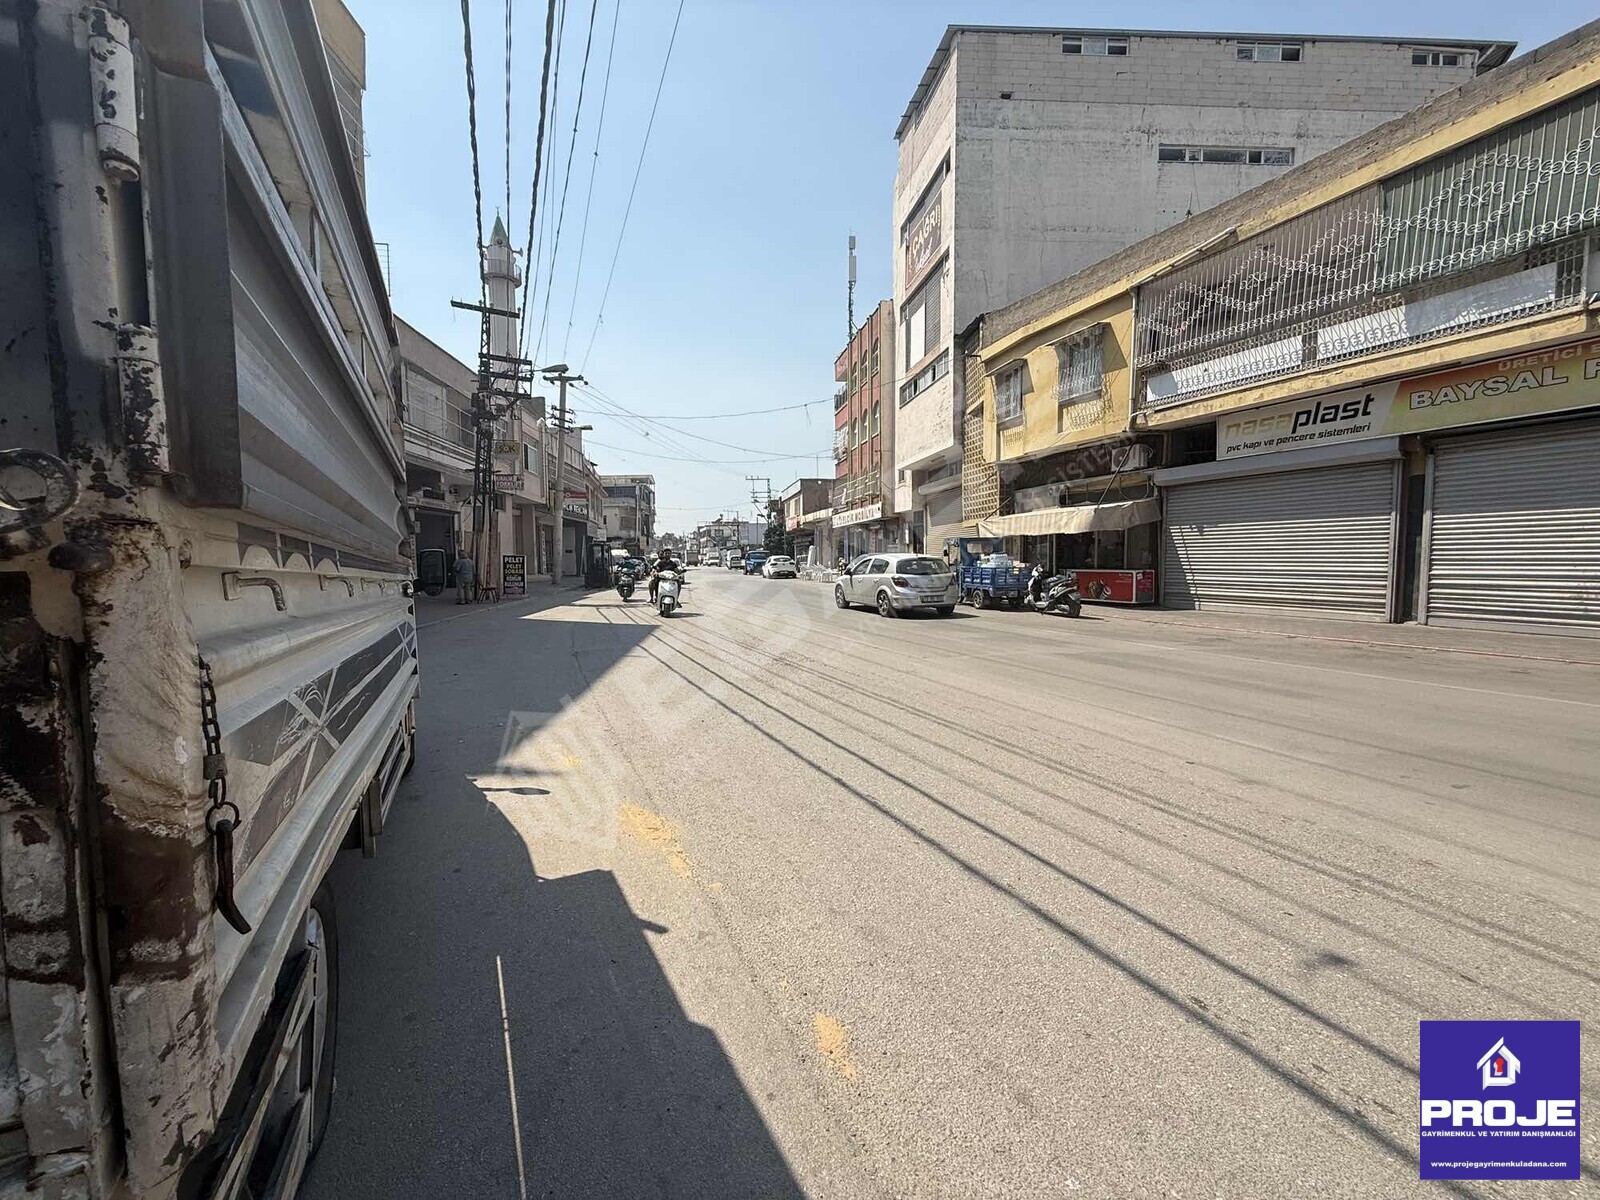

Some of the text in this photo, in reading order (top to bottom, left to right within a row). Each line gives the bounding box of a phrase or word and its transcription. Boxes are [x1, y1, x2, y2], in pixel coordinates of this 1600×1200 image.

[912, 206, 939, 258] ÇAĞRI
[1498, 345, 1583, 371] ÜRETİCİ
[1410, 366, 1569, 410] BAYSAL
[1225, 393, 1375, 439] nasaplast
[1226, 444, 1241, 453] pvc
[1243, 440, 1262, 450] kapı
[1276, 433, 1315, 446] pencere
[1318, 422, 1371, 439] sistemleri
